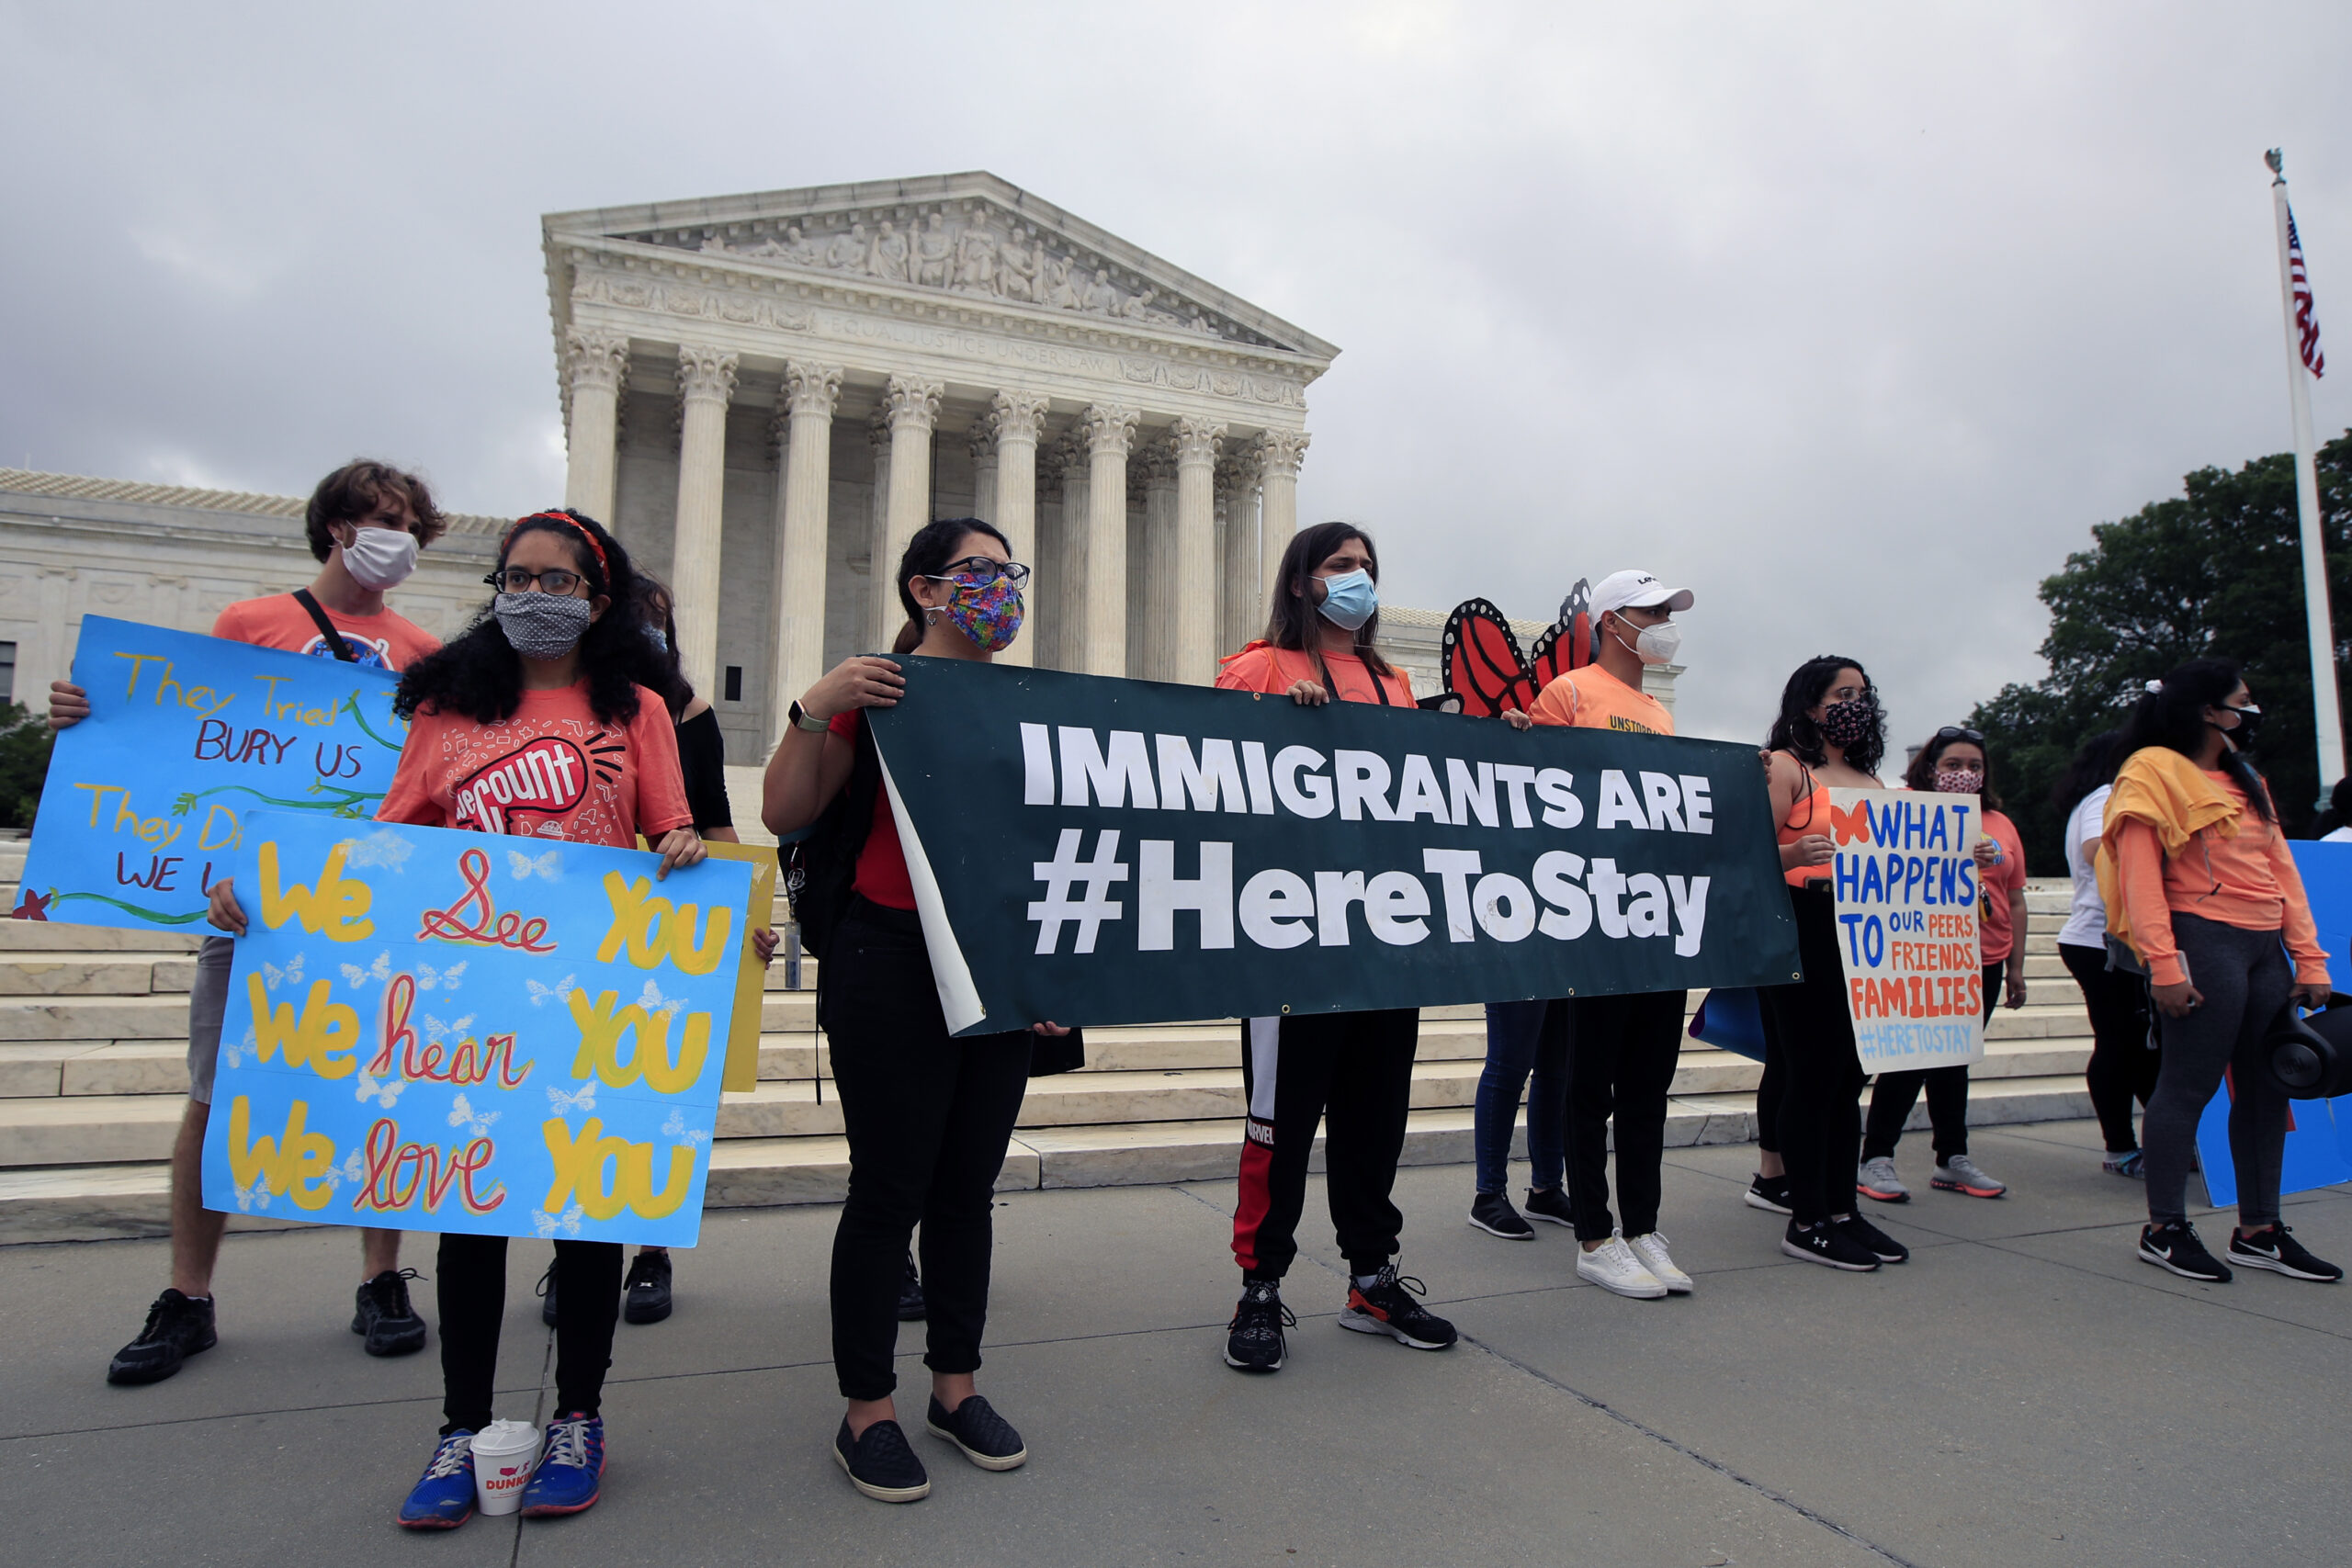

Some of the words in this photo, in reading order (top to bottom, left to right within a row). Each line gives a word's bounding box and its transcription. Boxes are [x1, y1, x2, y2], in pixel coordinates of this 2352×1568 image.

[831, 317, 902, 342] EQUAL
[908, 331, 986, 355] JUSTICE
[996, 343, 1060, 366] UNDER
[1068, 353, 1103, 370] LAW
[114, 651, 236, 720] They
[254, 675, 338, 727] Tried
[194, 718, 297, 765] BURY
[315, 742, 362, 779] US
[1019, 721, 1584, 829] IMMIGRANTS
[1597, 769, 1713, 835] ARE
[74, 783, 183, 853] They
[1865, 799, 1970, 852] WHAT
[117, 851, 185, 892] WE
[259, 841, 375, 942] We
[419, 849, 558, 953] See
[1026, 828, 1713, 958] #HereToStay
[1836, 852, 1975, 907] HAPPENS
[1838, 913, 1883, 968] TO
[1889, 910, 1925, 932] OUR
[1849, 974, 1983, 1021] FAMILIES
[247, 972, 360, 1080] We
[368, 974, 535, 1088] hear
[1859, 1023, 1973, 1059] #HERETOSTAY
[228, 1095, 336, 1211] We
[353, 1118, 506, 1213] love
